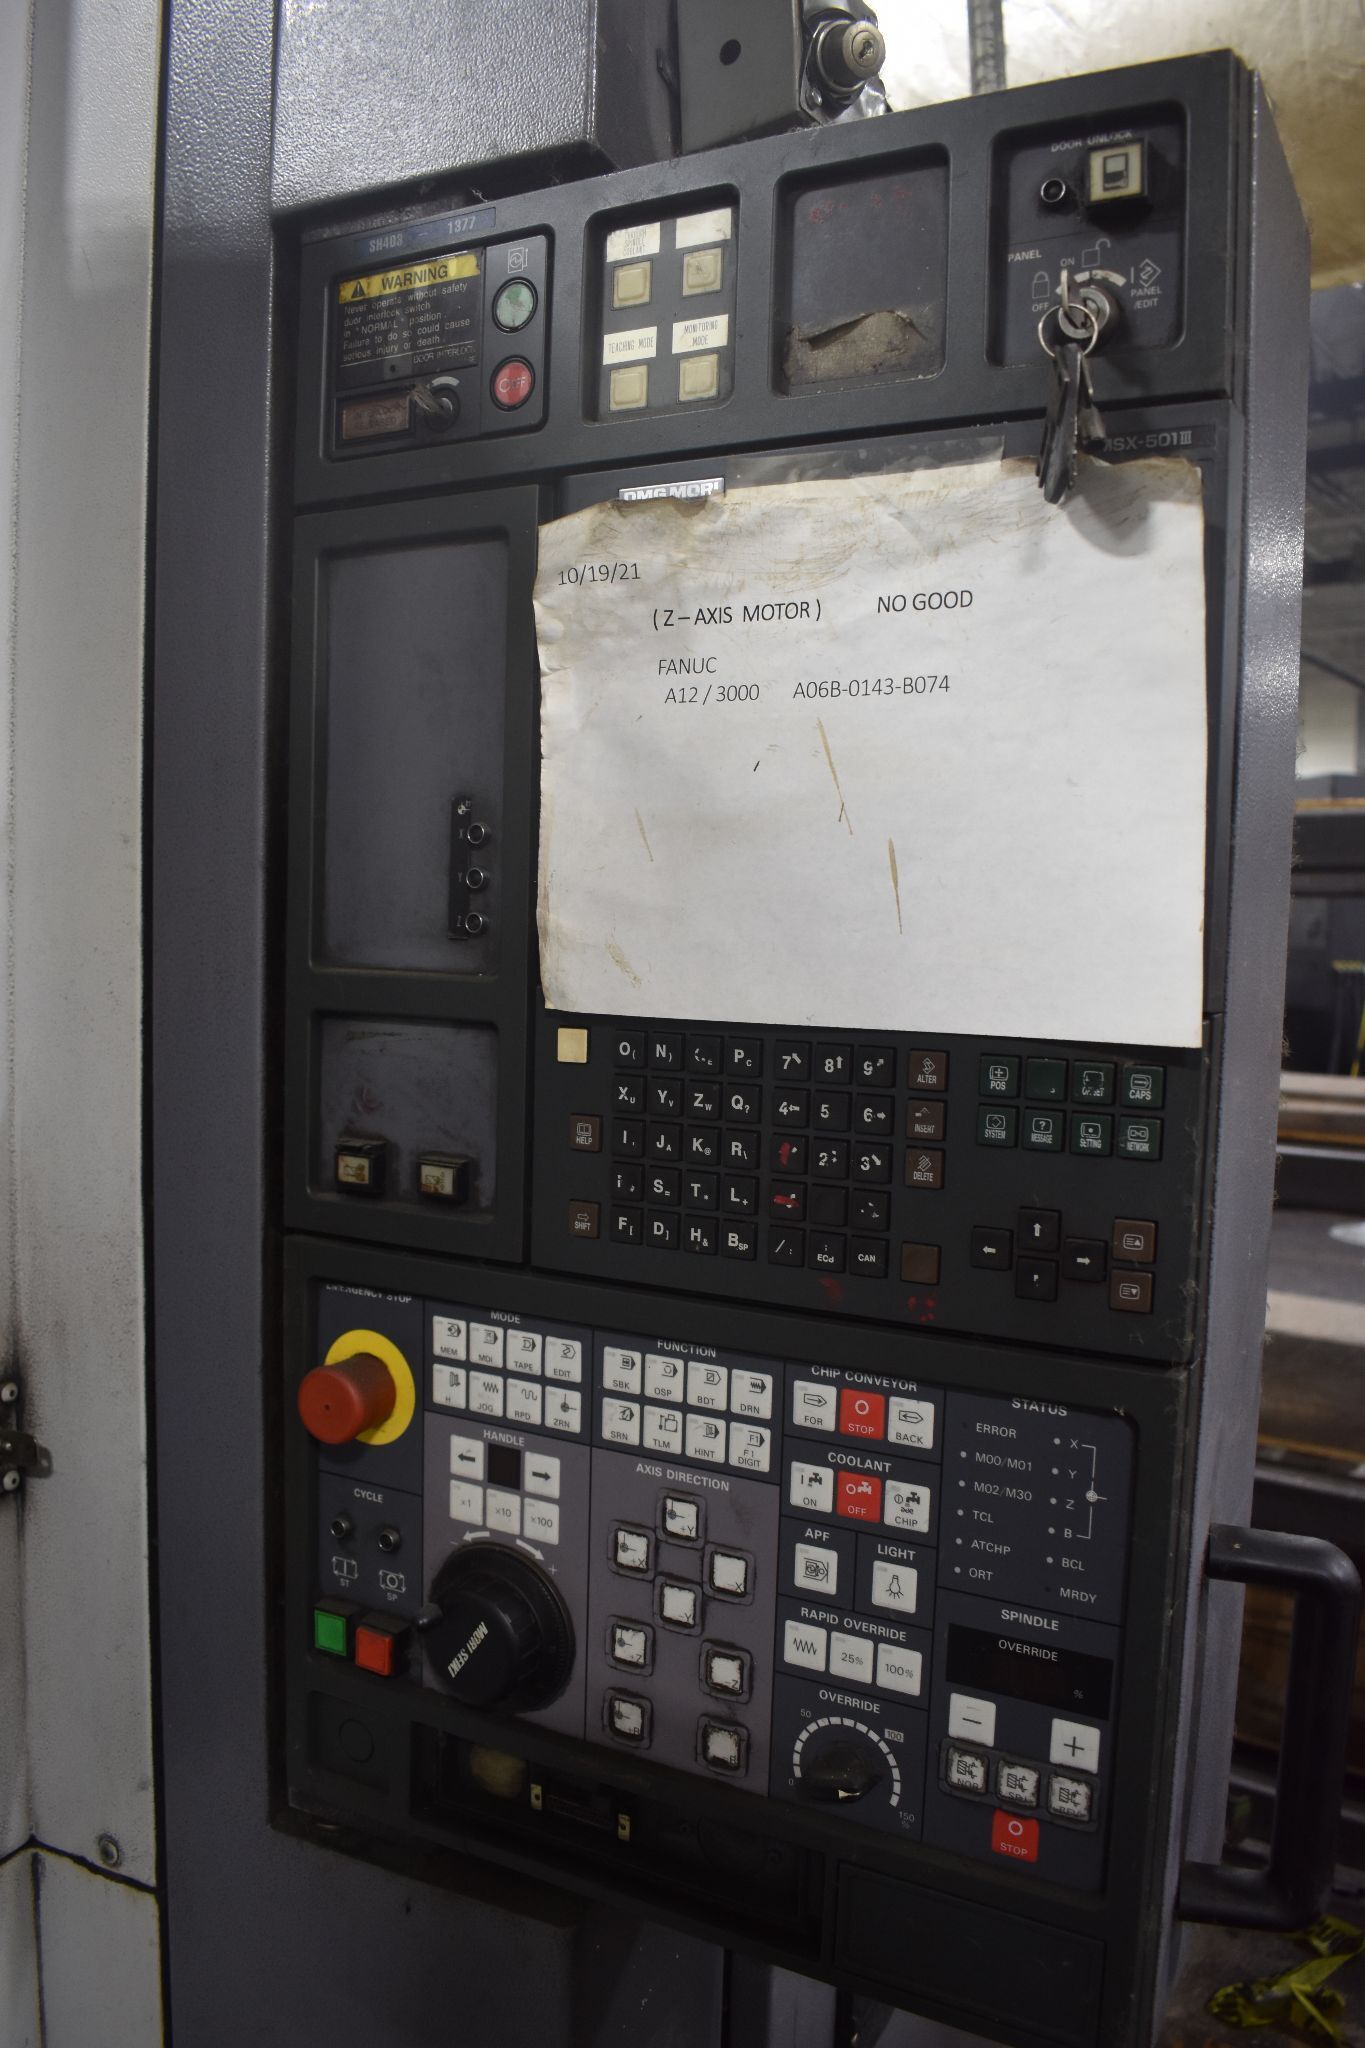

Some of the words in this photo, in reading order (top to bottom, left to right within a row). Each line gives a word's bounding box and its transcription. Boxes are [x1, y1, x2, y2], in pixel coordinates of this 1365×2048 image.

[1008, 250, 1042, 262] PANEL
[1060, 257, 1075, 266] ON
[381, 264, 448, 291] WARNING
[407, 287, 437, 301] without
[442, 282, 468, 295] safety
[1130, 286, 1162, 297] PANEL
[405, 301, 431, 314] switch
[1032, 303, 1049, 313] OFF
[374, 335, 382, 343] to
[387, 332, 398, 341] do
[417, 323, 440, 335] could
[444, 318, 470, 330] cause
[608, 340, 635, 354] TEACHING
[638, 336, 654, 349] MODE
[692, 335, 709, 347] MODE
[376, 342, 399, 355] injury
[558, 562, 641, 587] 10/19/21
[877, 594, 906, 614] NO
[912, 590, 974, 611] GOOD
[658, 656, 718, 676] FANUC
[793, 675, 951, 699] A06B-0143-B074
[917, 1074, 937, 1084] ALTER
[990, 1081, 1006, 1091] POS
[1129, 1089, 1151, 1100] CAPS
[984, 1128, 1006, 1139] SYSTEM
[576, 1136, 592, 1146] HELP
[914, 1171, 933, 1182] DELETE
[574, 1221, 591, 1231] SHIFT
[858, 1254, 876, 1263] CAN
[491, 1311, 521, 1324] MODE
[441, 1347, 458, 1356] MEM
[657, 1339, 716, 1358] FUNCTION
[478, 1354, 492, 1363] MDI
[514, 1361, 533, 1371] TAPE
[553, 1368, 571, 1378] EDIT
[811, 1365, 841, 1379] CHIP
[845, 1370, 918, 1392] CONVEYOR
[612, 1380, 630, 1390] SBK
[654, 1387, 672, 1397] OSP
[697, 1396, 715, 1406] BDT
[478, 1403, 494, 1412] JOG
[740, 1404, 760, 1414] DRN
[1012, 1398, 1068, 1417] STATUS
[515, 1410, 531, 1420] RPD
[804, 1415, 823, 1426] FOR
[553, 1418, 570, 1428] ZRN
[848, 1423, 875, 1434] STOP
[611, 1431, 628, 1441] SRN
[976, 1423, 1017, 1439] ERROR
[483, 1430, 525, 1446] HANDLE
[652, 1439, 671, 1449] TLM
[895, 1432, 924, 1445] BACK
[1070, 1438, 1079, 1449] X
[694, 1448, 716, 1458] HINT
[738, 1457, 761, 1467] DIGIT
[827, 1452, 892, 1473] COOLANT
[636, 1463, 662, 1477] AXIS
[666, 1469, 729, 1491] DIRECTION
[1068, 1469, 1078, 1479] Y
[354, 1487, 384, 1503] CYCLE
[803, 1497, 817, 1507] ON
[1065, 1500, 1075, 1510] Z
[847, 1506, 866, 1516] OFF
[972, 1510, 995, 1524] TCL
[895, 1516, 918, 1527] CHIP
[804, 1528, 831, 1541] APF
[1064, 1528, 1072, 1538] B
[877, 1544, 917, 1561] LIGHT
[971, 1539, 1011, 1555] ATCHP
[1062, 1558, 1085, 1571] BCL
[969, 1568, 994, 1581] ORT
[340, 1578, 350, 1587] ST
[1060, 1587, 1098, 1604] MRDY
[800, 1607, 839, 1625] RAPID
[843, 1617, 907, 1642] OVERRIDE
[1001, 1609, 1060, 1631] SPINDLE
[466, 1621, 488, 1654] MORI
[998, 1639, 1058, 1662] OVERRIDE
[447, 1648, 469, 1678] SEIKI
[841, 1652, 864, 1666] 25%
[885, 1663, 914, 1679] 100%
[819, 1689, 881, 1714] OVERRIDE
[800, 1708, 812, 1718] 50
[887, 1730, 902, 1741] 100
[899, 1811, 915, 1823] 150
[1000, 1842, 1028, 1856] STOP
